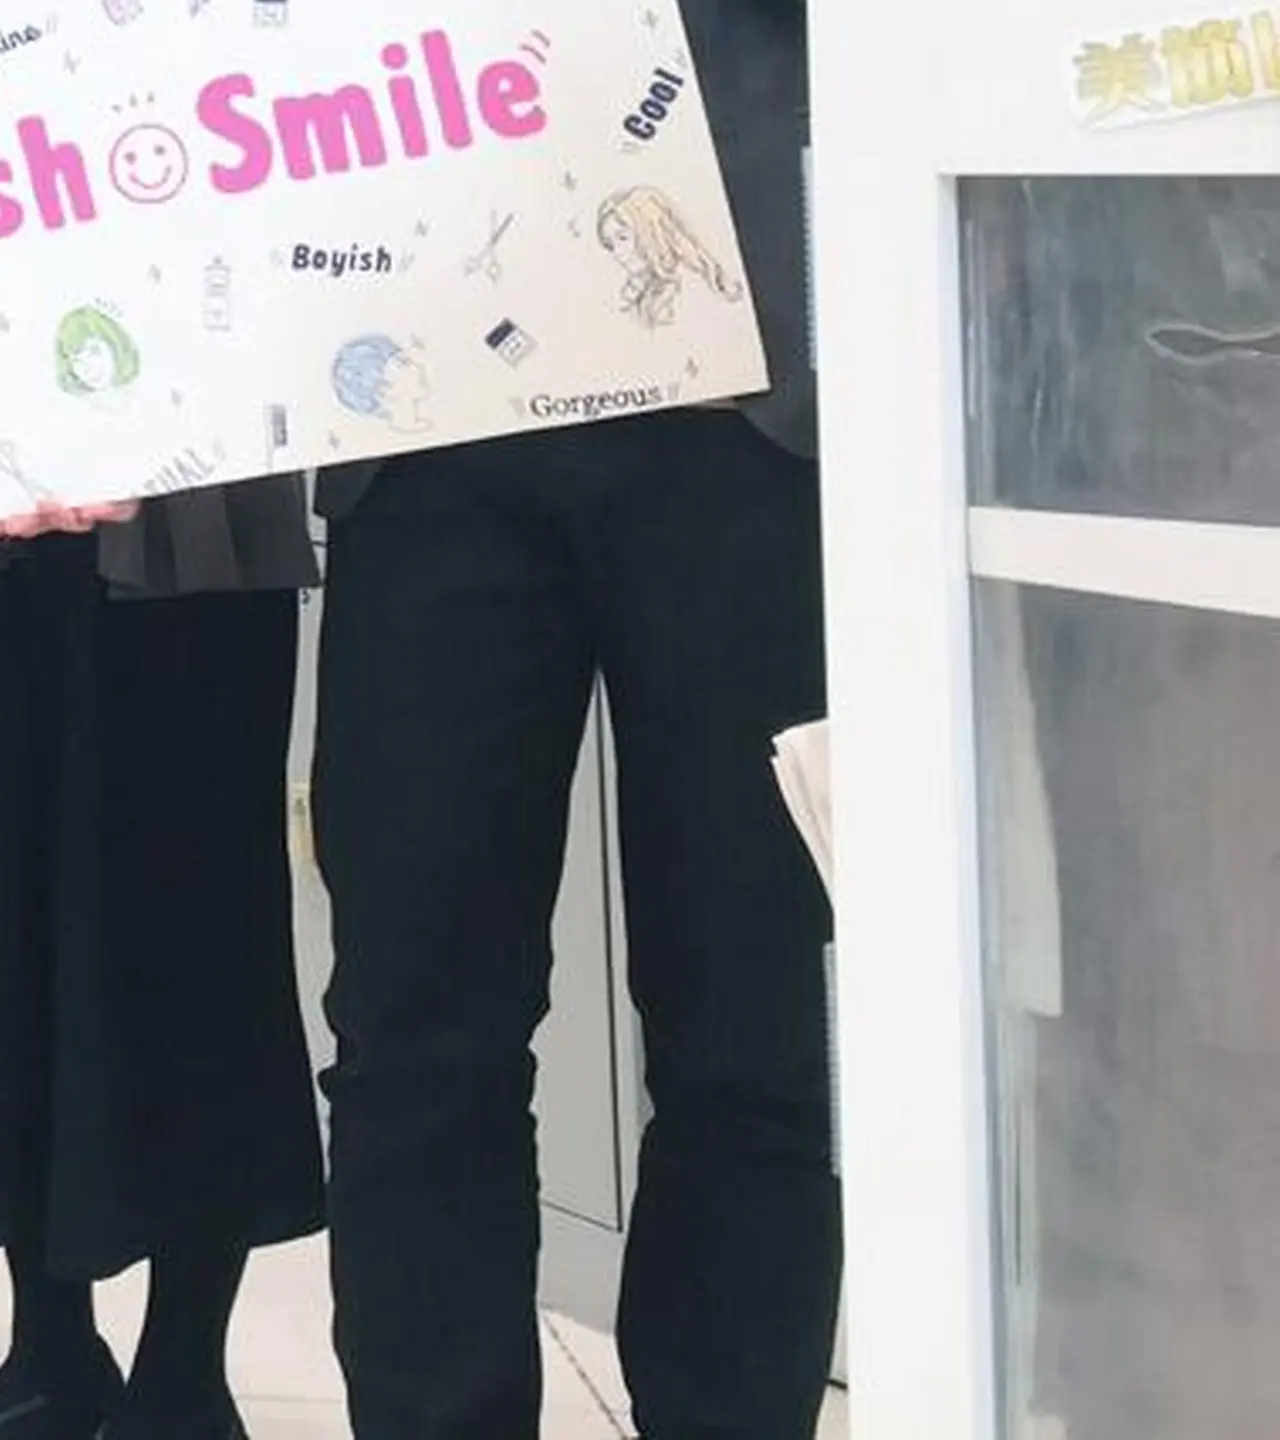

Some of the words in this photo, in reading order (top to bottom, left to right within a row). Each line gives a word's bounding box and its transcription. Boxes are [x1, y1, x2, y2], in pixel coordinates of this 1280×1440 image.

[197, 30, 546, 194] Smile
[291, 242, 392, 277] Boyish
[529, 385, 662, 418] Gorgeous
